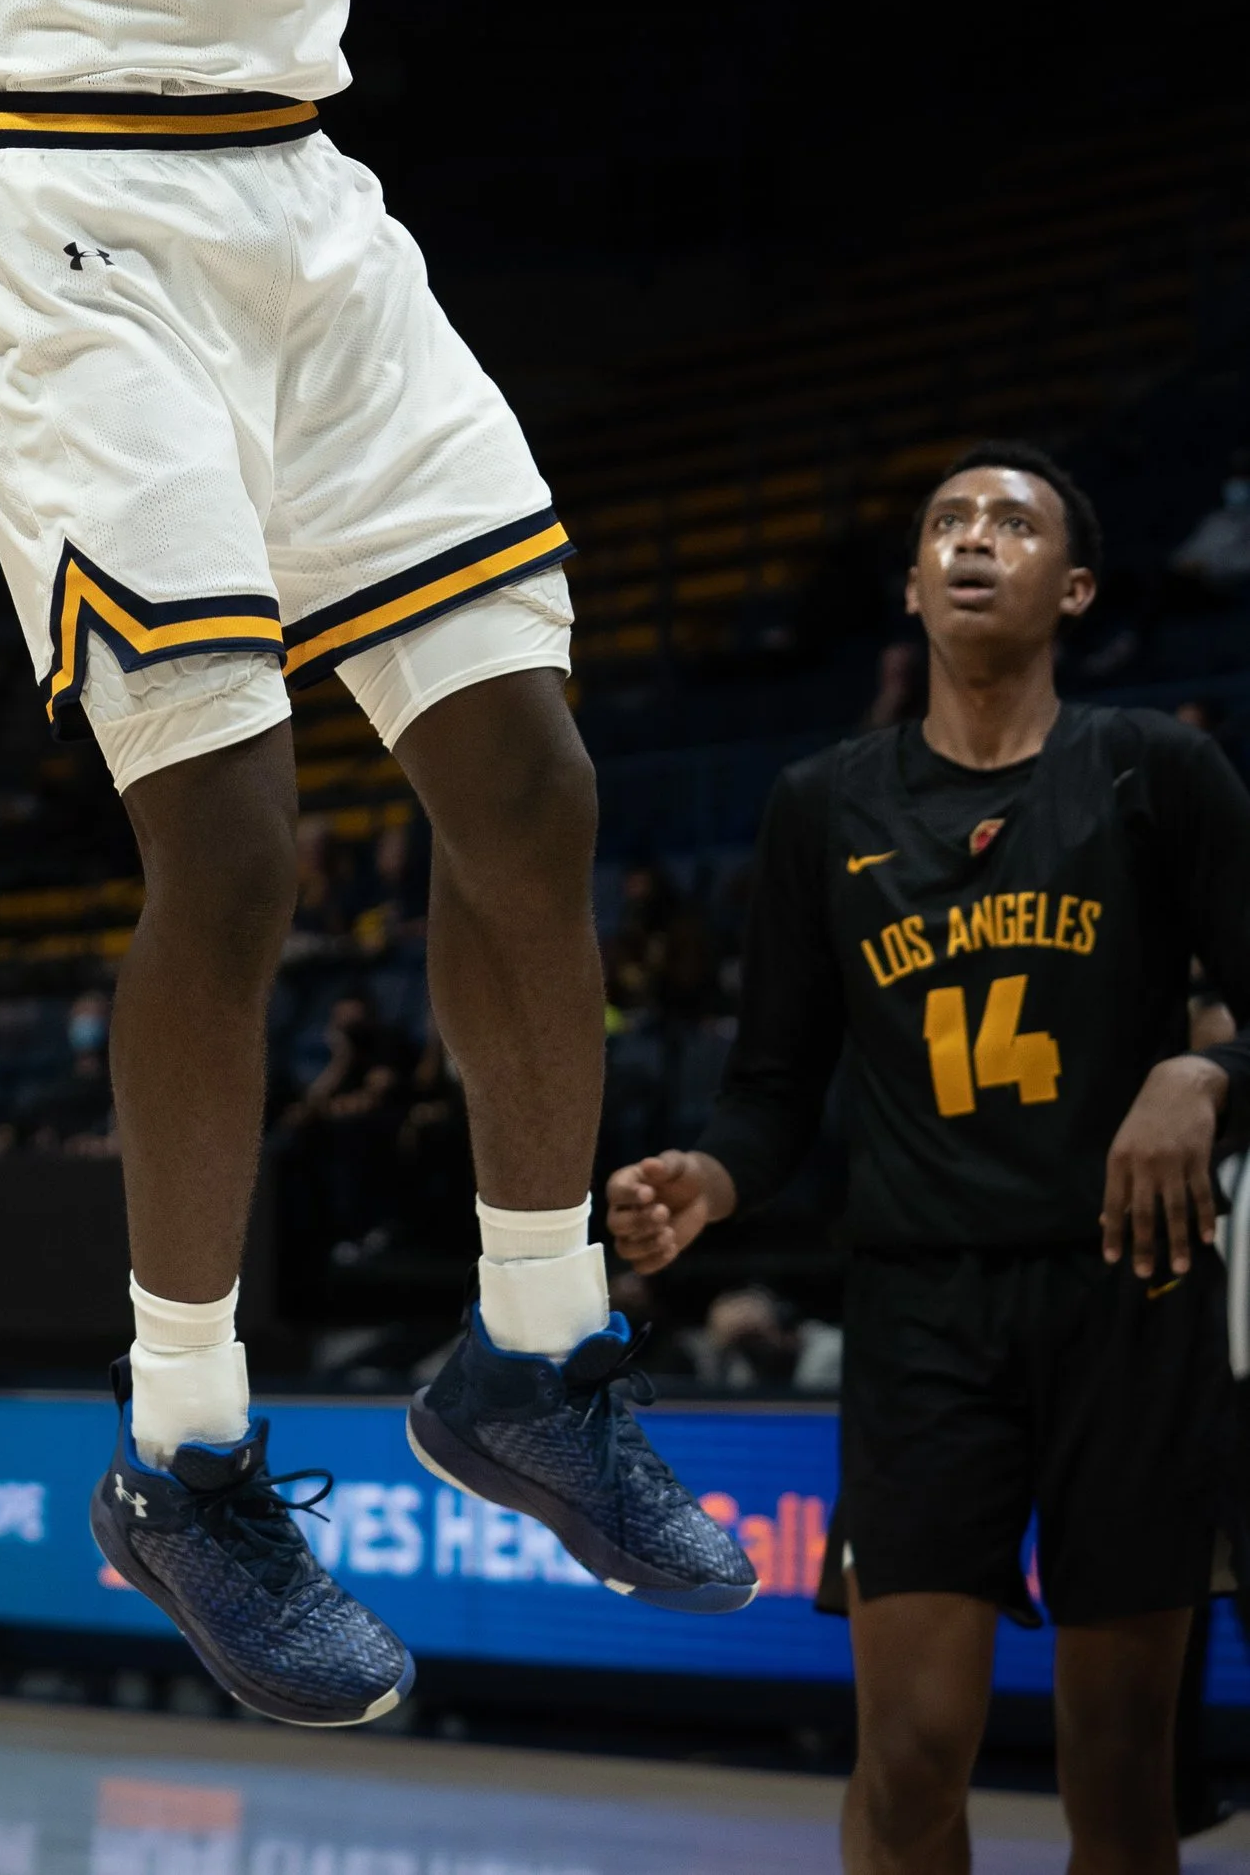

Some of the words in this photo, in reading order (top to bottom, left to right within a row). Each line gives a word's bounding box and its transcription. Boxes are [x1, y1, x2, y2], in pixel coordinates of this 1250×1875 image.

[861, 915, 935, 988] LOS
[947, 891, 1103, 956] ANGELES
[923, 974, 1062, 1118] 14
